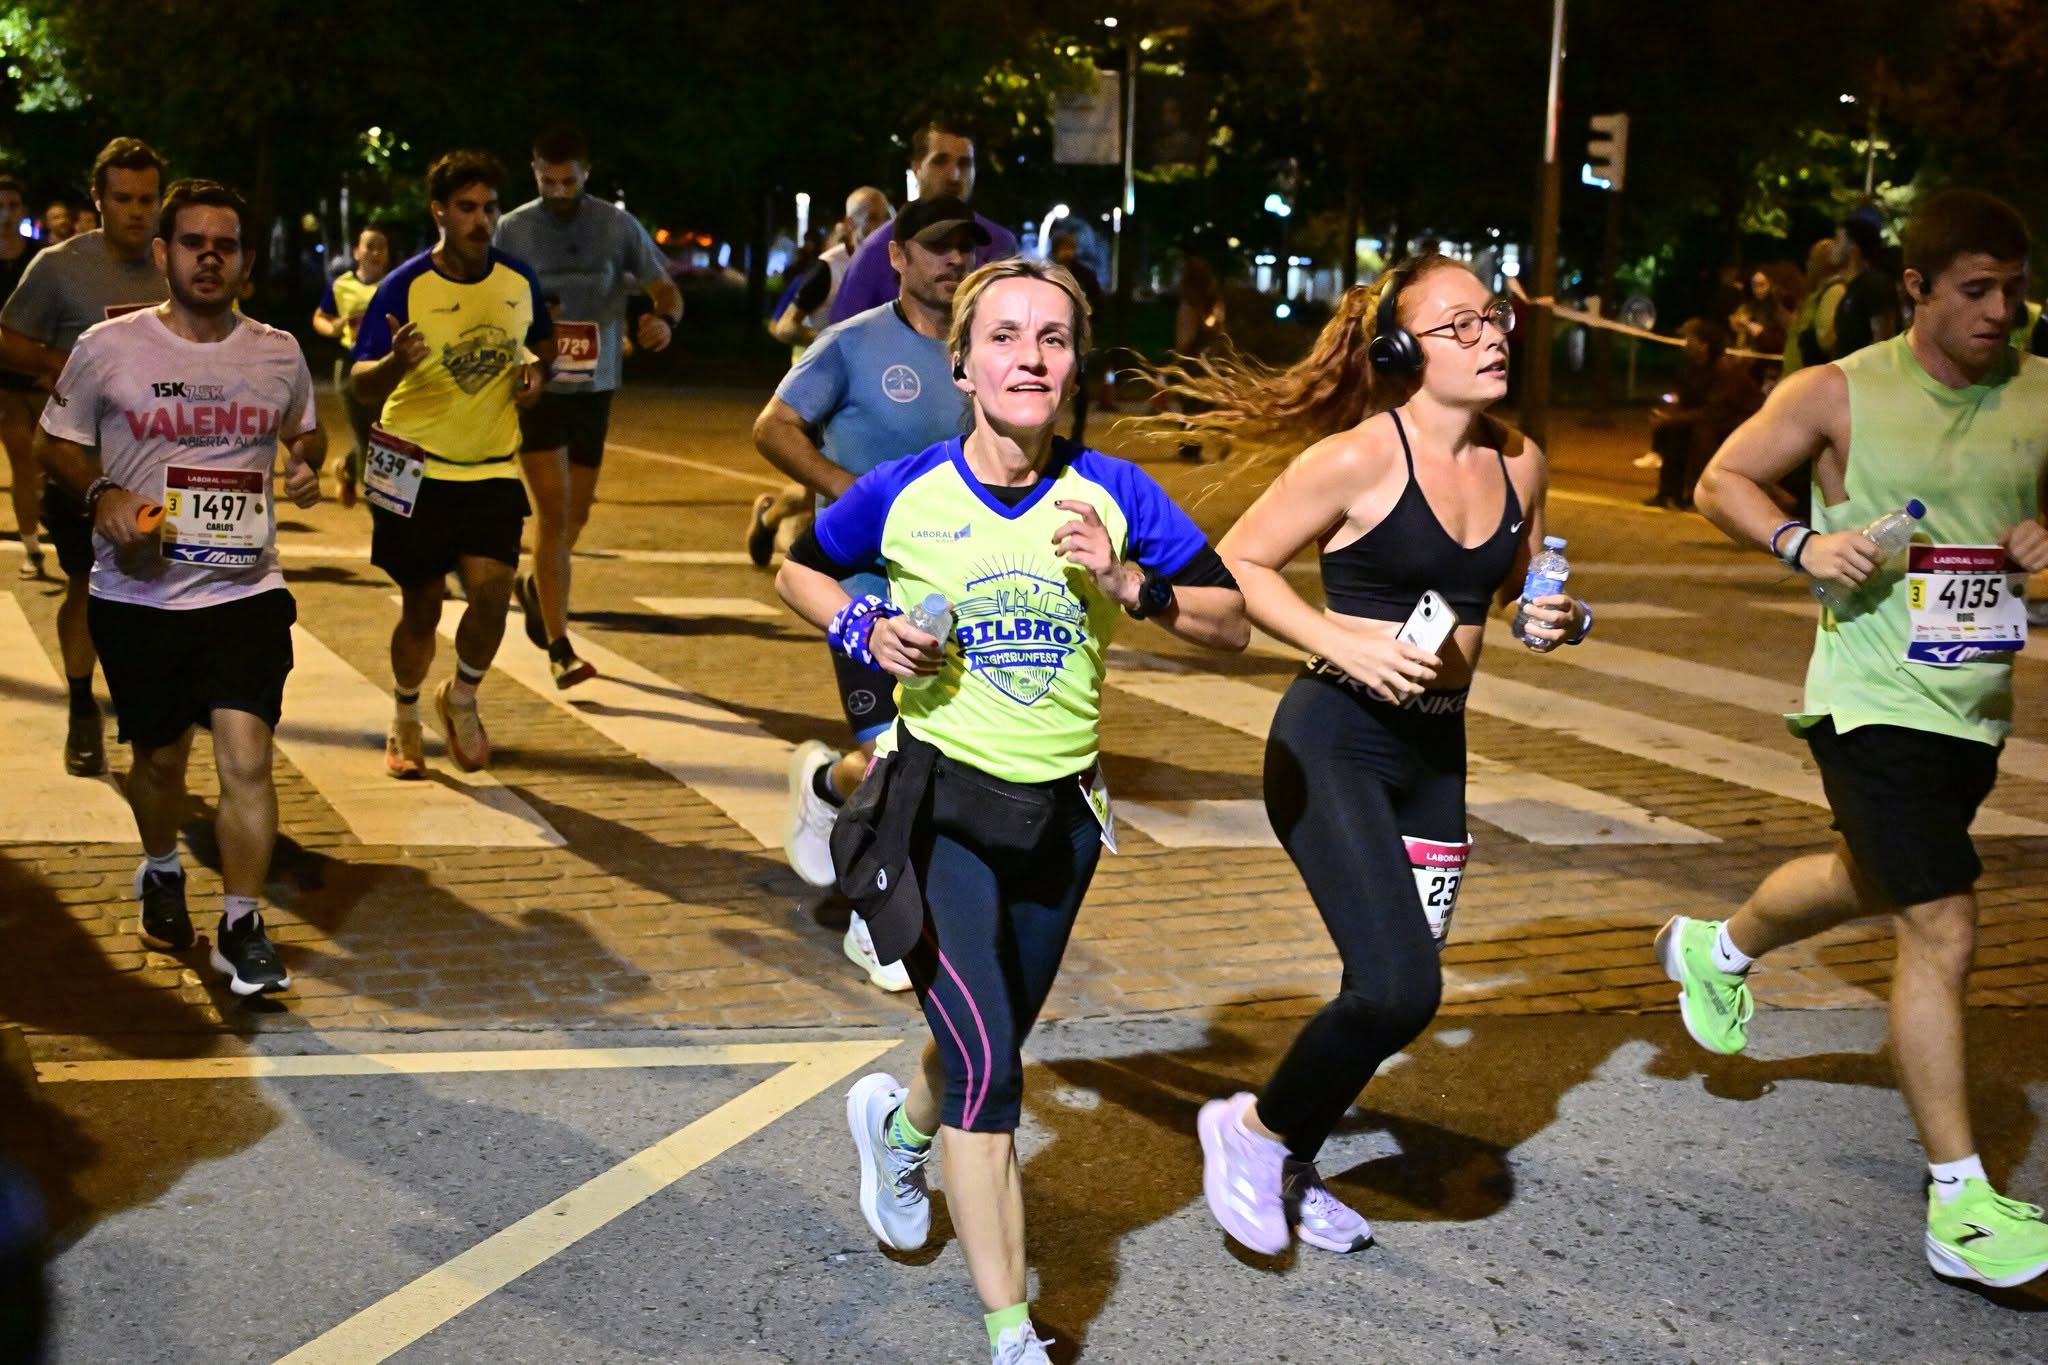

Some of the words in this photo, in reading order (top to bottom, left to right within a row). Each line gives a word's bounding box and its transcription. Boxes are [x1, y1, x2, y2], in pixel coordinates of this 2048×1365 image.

[152, 382, 187, 398] 15K
[185, 384, 226, 403] 7.5K
[177, 435, 230, 448] ABIERTA
[367, 445, 406, 477] 2439
[187, 474, 220, 484] LABORAL
[169, 497, 177, 512] 3
[192, 494, 247, 521] 1497
[206, 522, 234, 532] CARLOS
[911, 530, 953, 538] LABORAL
[1933, 556, 1973, 565] LABORAL
[1912, 586, 1920, 603] 3
[1939, 578, 2002, 610] 4135
[956, 617, 1072, 647] BILBAO
[1095, 798, 1103, 814] 3
[1426, 852, 1461, 863] LABORAL
